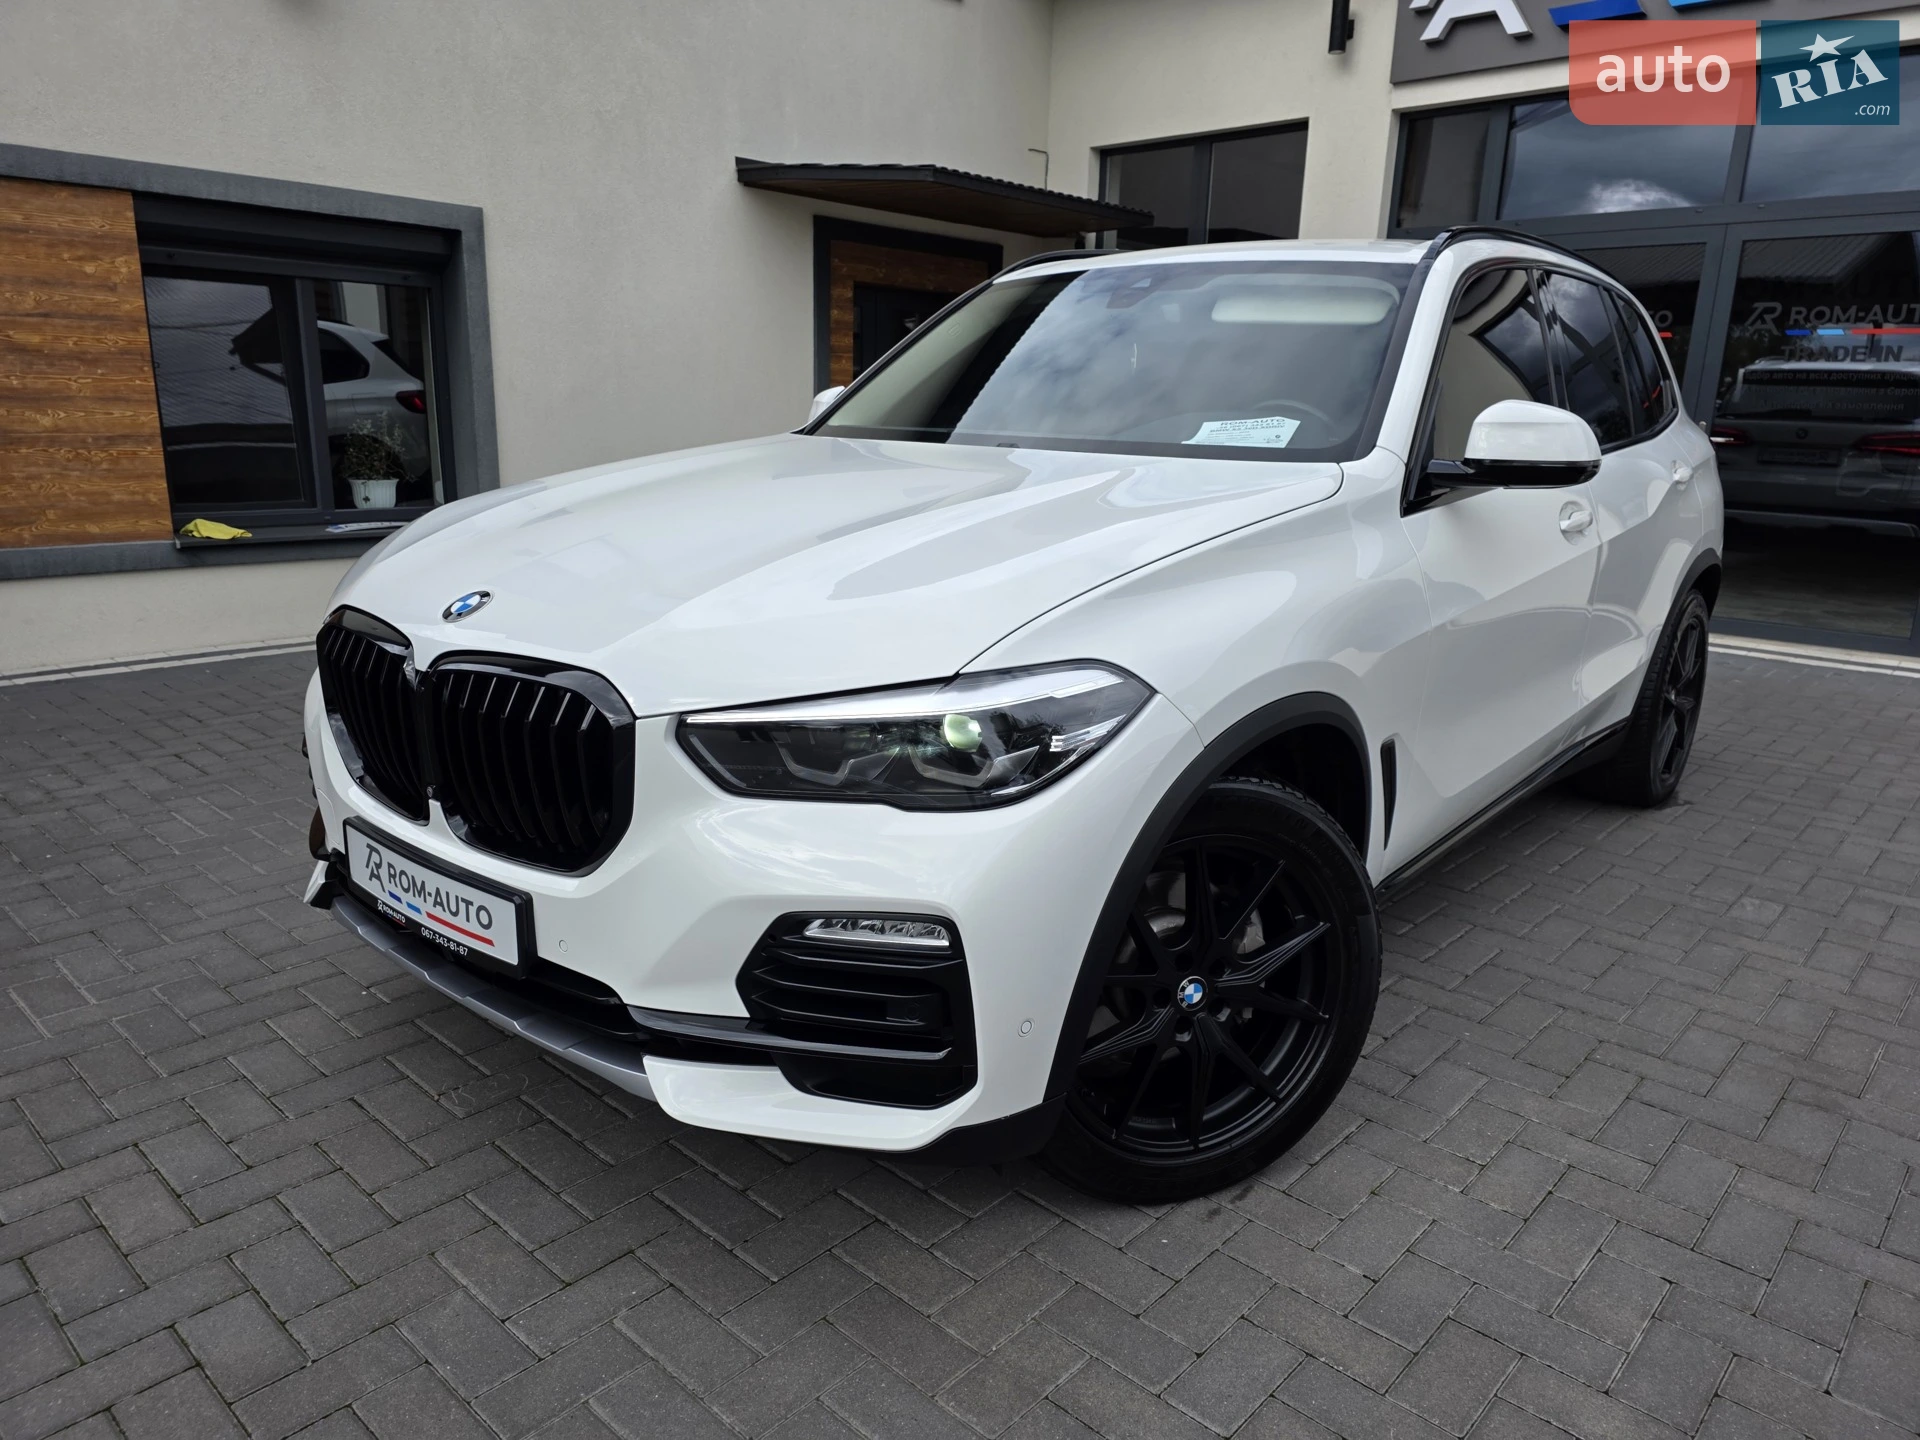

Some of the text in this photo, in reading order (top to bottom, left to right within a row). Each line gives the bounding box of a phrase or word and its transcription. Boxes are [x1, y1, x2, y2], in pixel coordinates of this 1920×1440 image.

[387, 861, 493, 931] ROM-AUTO
[383, 905, 406, 924] ROM-AUTO
[421, 927, 469, 957] 067-343-81-87
